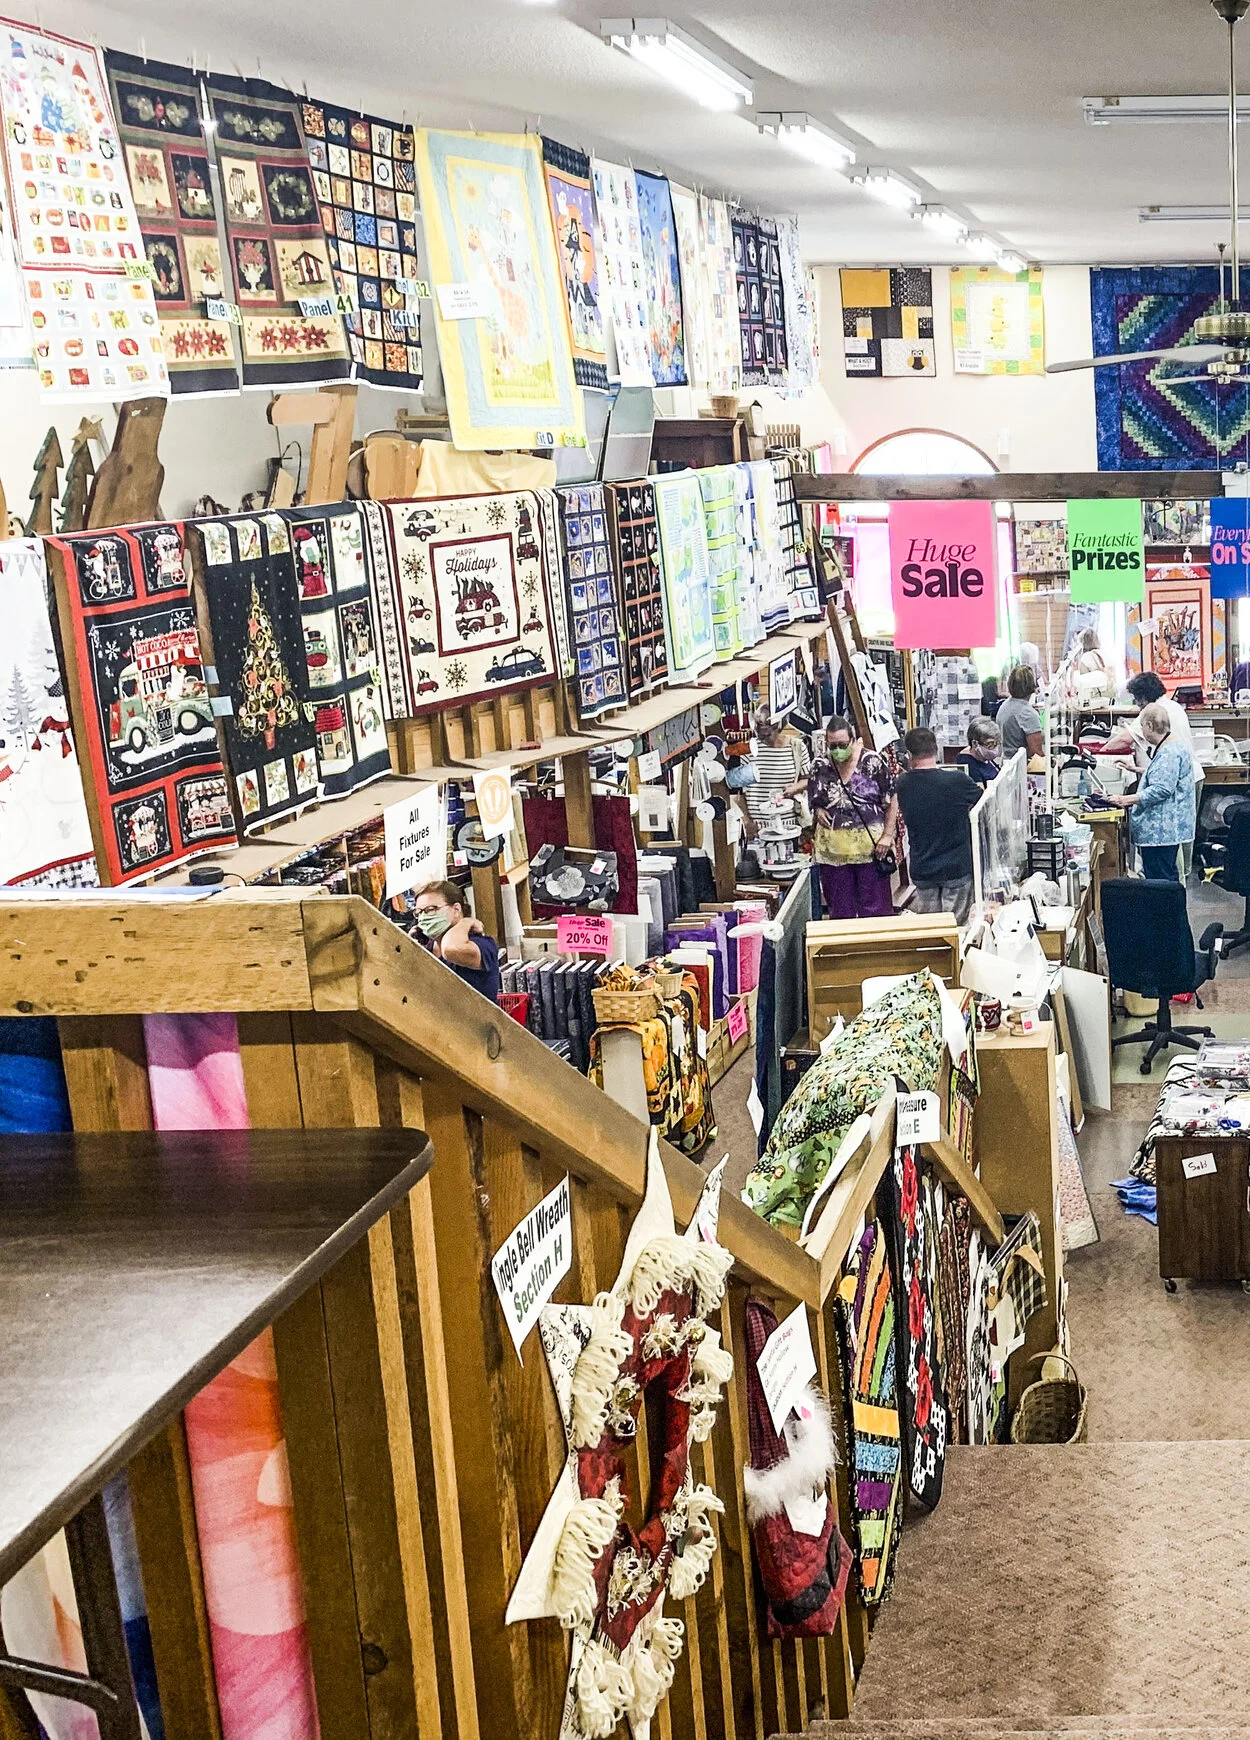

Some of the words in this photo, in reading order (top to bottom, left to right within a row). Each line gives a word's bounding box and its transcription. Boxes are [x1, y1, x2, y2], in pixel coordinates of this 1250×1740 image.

[302, 300, 333, 317] Panel
[336, 294, 355, 313] 41
[796, 544, 806, 554] 65
[1073, 532, 1139, 547] Fantastic
[455, 548, 477, 557] HAPPY
[906, 539, 977, 569] Huge
[1071, 548, 1140, 571] Prizes
[1213, 542, 1237, 565] On
[446, 557, 498, 575] Holidays
[901, 563, 984, 598] Sale
[408, 807, 420, 825] All
[399, 826, 430, 851] Fixtures
[400, 857, 414, 872] For
[415, 845, 431, 863] Sale
[585, 917, 605, 928] Sale
[566, 932, 591, 945] 20%
[593, 933, 609, 947] Off
[1187, 1160, 1208, 1171] Sold
[517, 1217, 535, 1266] Bell
[535, 1184, 569, 1243] Wreath
[513, 1255, 552, 1323] Section
[553, 1233, 563, 1267] H
